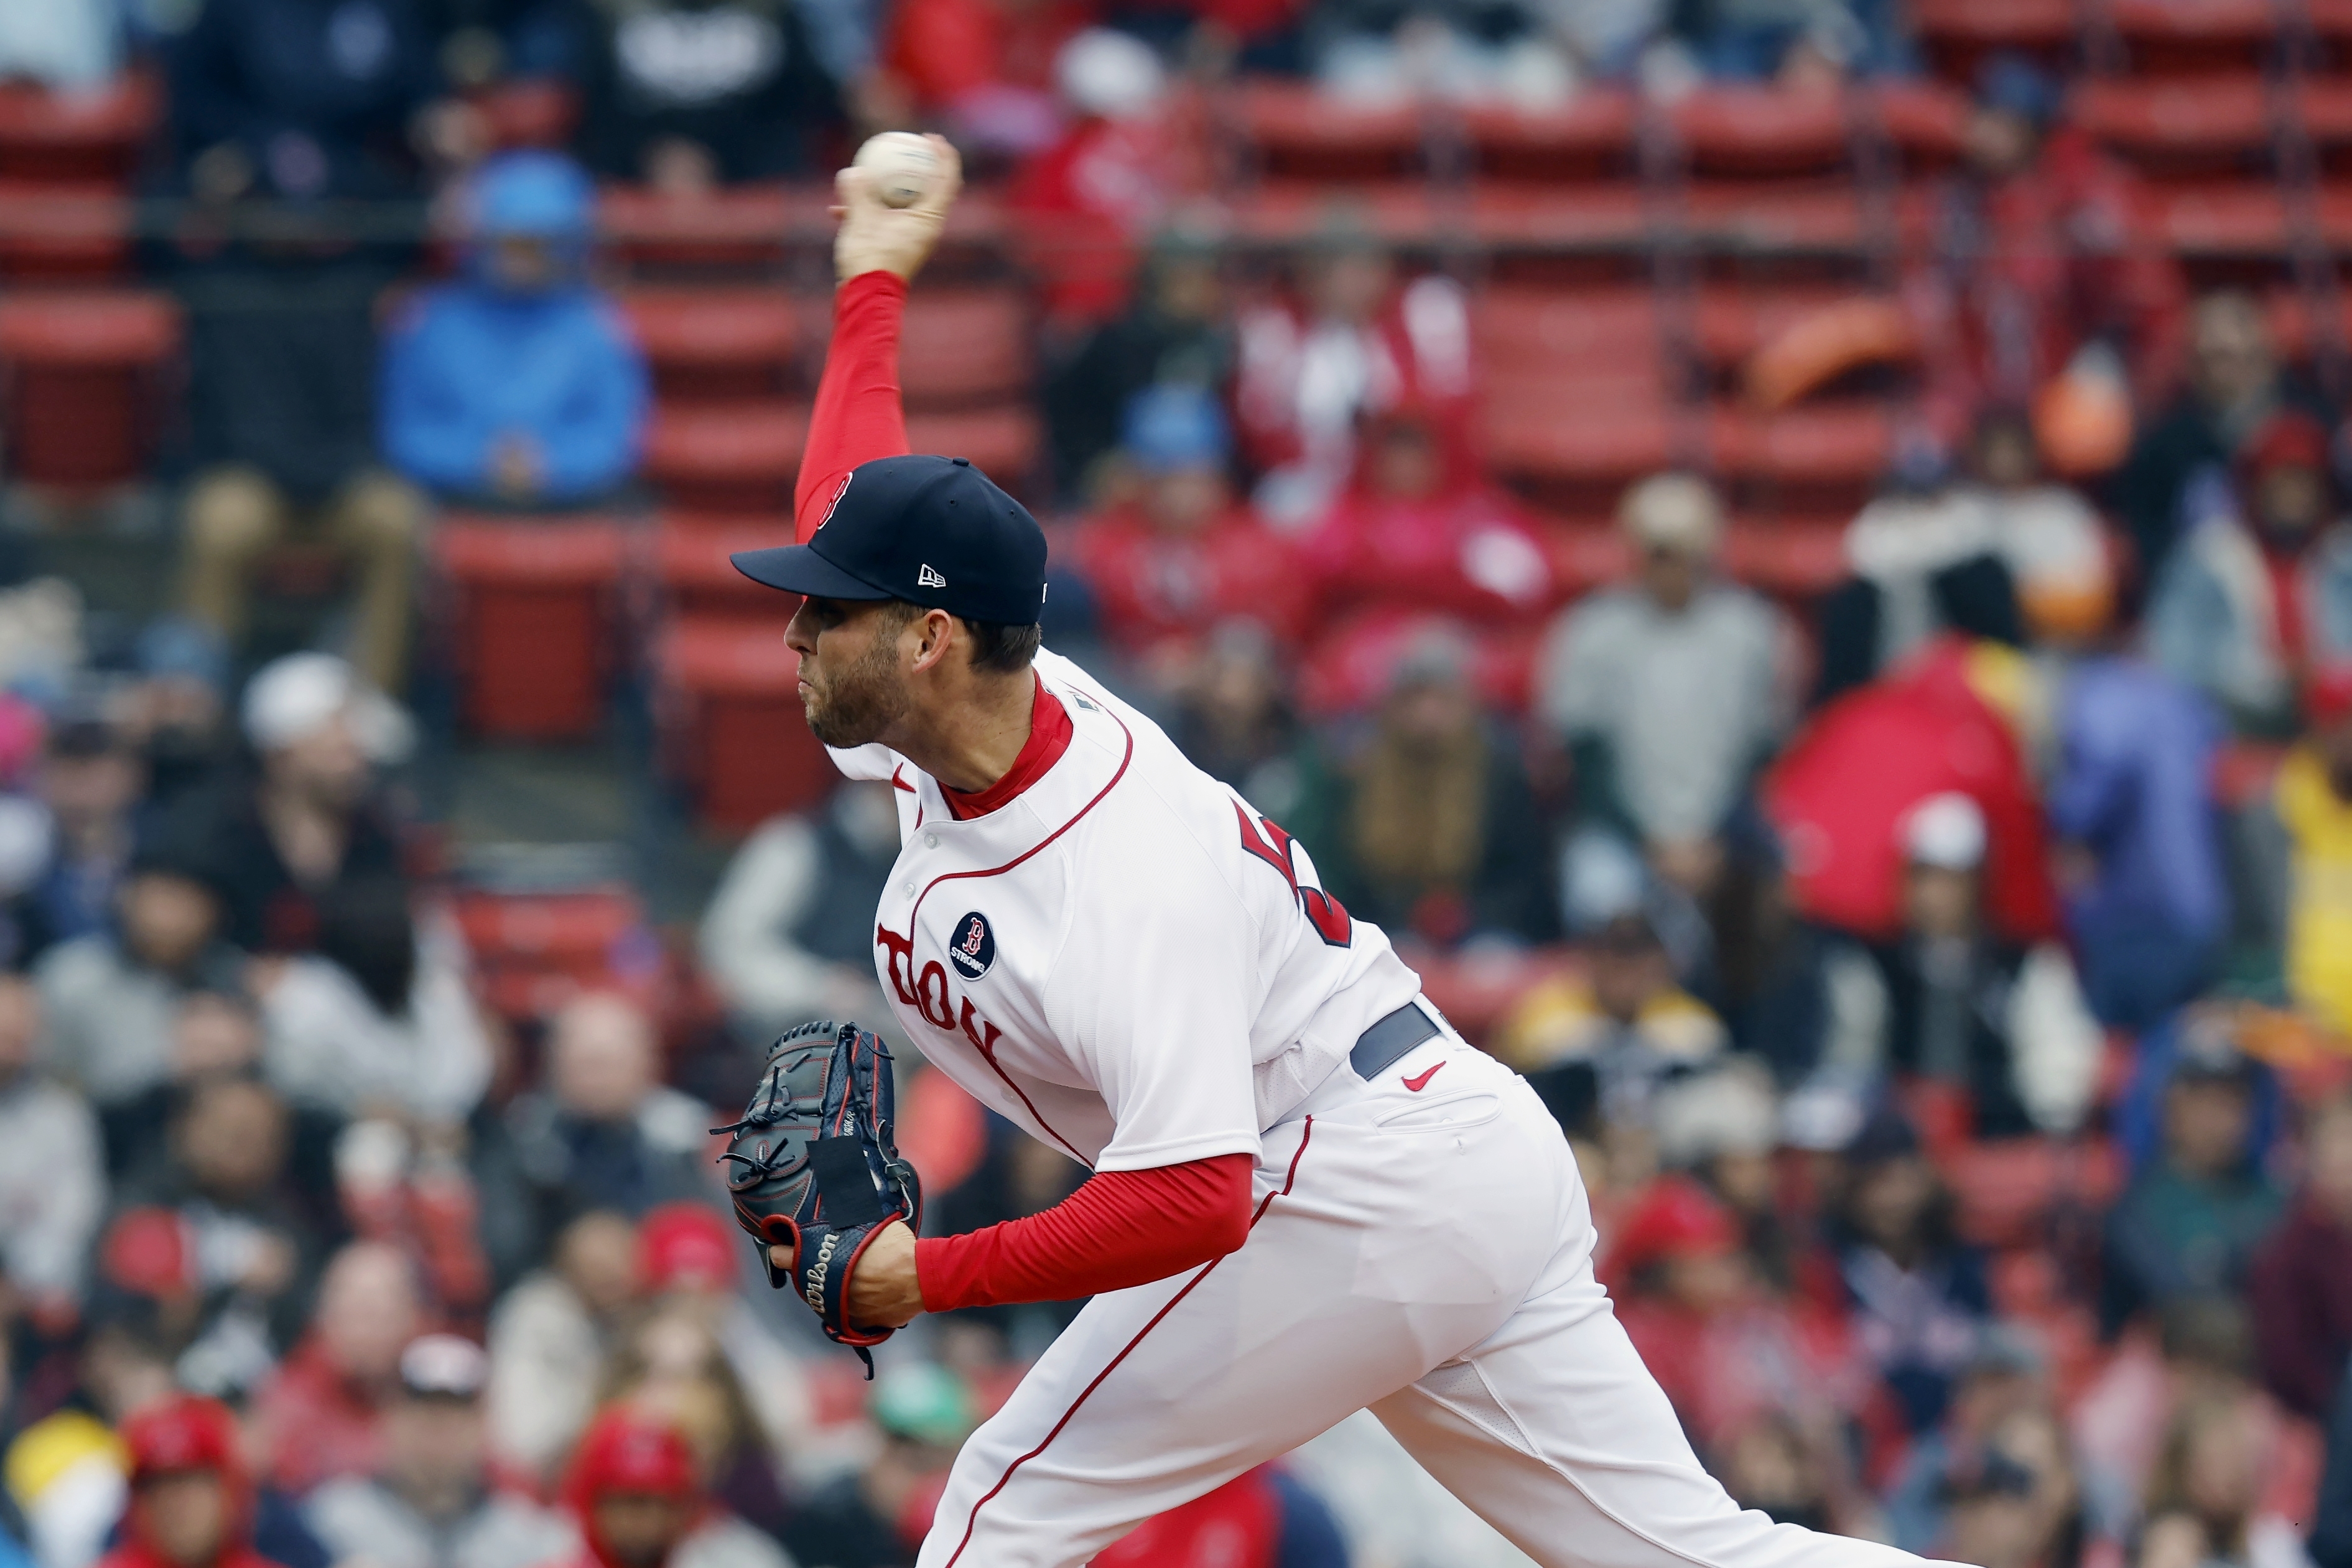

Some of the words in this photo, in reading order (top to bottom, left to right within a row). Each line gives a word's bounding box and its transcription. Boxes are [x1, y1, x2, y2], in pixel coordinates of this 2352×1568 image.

[962, 917, 985, 955] B
[951, 947, 985, 973] STRONG
[806, 1233, 840, 1313] Wilson
